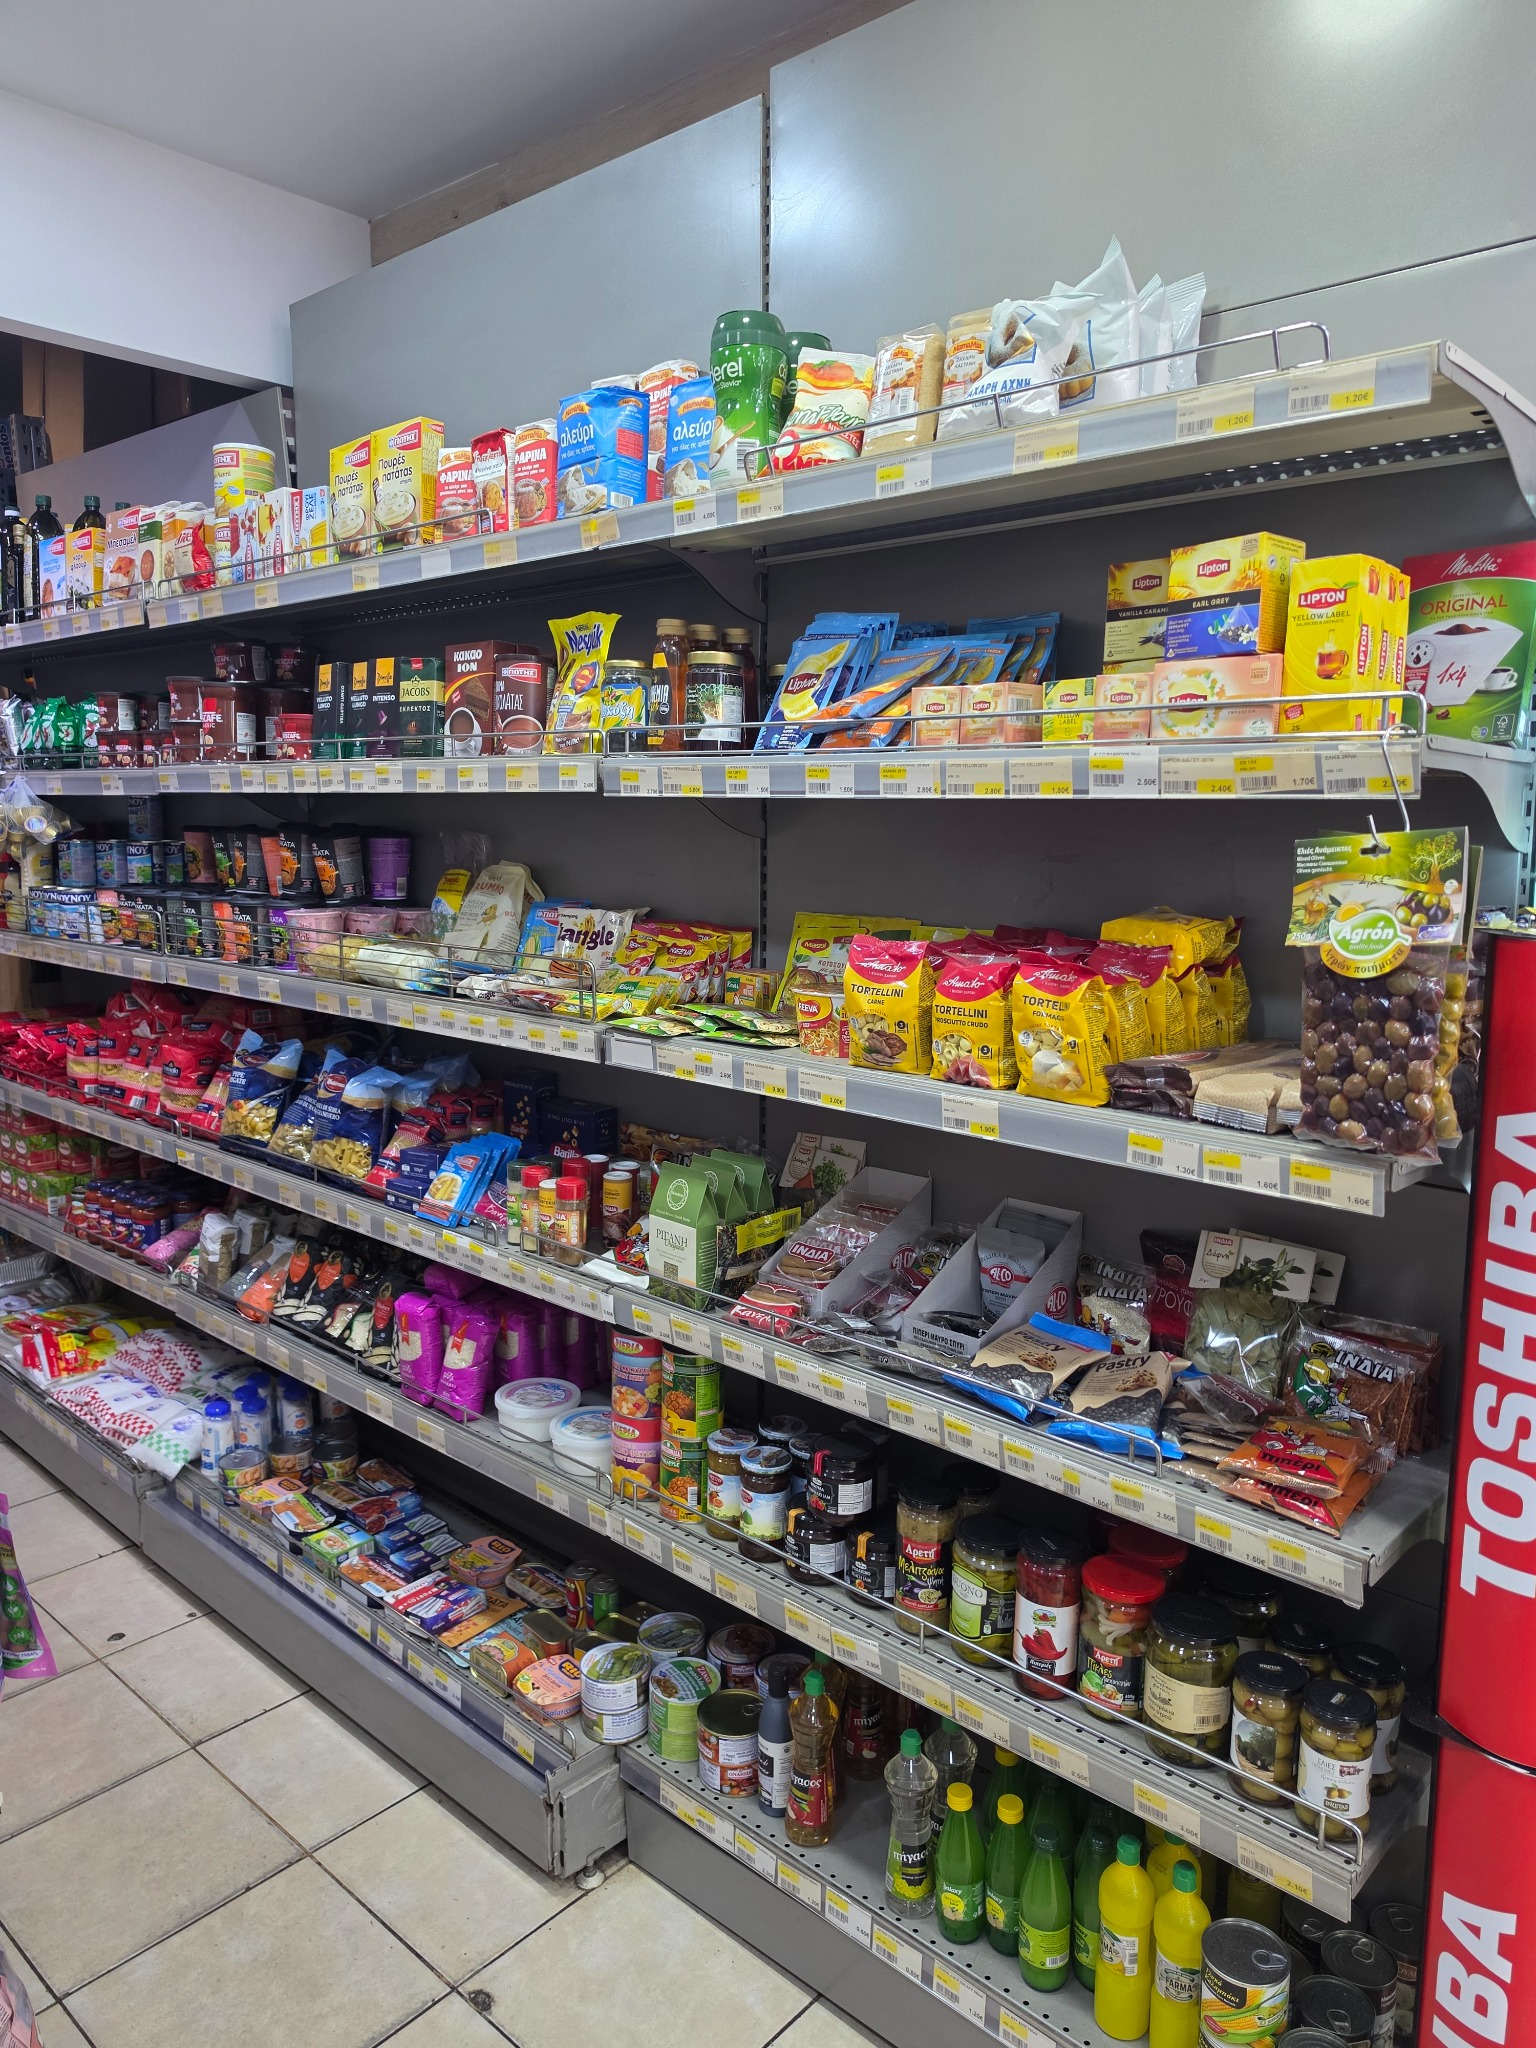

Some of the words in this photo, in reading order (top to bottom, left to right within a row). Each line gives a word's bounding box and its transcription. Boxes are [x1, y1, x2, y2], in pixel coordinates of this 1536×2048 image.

[1345, 392, 1369, 404] 1.20€
[1226, 414, 1249, 427] 1.20€
[560, 423, 594, 448] αλεύρι
[1199, 563, 1228, 576] Lipton
[1134, 578, 1160, 589] Lipton
[1192, 599, 1210, 608] EARL
[1210, 597, 1230, 606] GREY
[1300, 590, 1346, 606] LIPTON
[1420, 594, 1508, 616] ORIGINAL
[1118, 609, 1142, 618] VANILLA
[1292, 612, 1324, 622] YELLOW
[1324, 610, 1350, 618] LABEL
[1358, 626, 1368, 675] LIPTON
[401, 687, 430, 698] JACOBS
[1111, 693, 1131, 702] Lipton
[927, 703, 944, 711] Lipton
[973, 702, 991, 710] Lipton
[1137, 778, 1157, 786] 2.50€
[1292, 776, 1315, 786] 1.70€
[1210, 784, 1232, 793] 2.40€
[1353, 947, 1404, 974] ποιήματα
[850, 983, 904, 998] TORTELLINI
[867, 998, 885, 1006] CARNE
[934, 1004, 988, 1019] TORTELLINI
[967, 1020, 989, 1029] CRUDO
[979, 1125, 996, 1134] 1.90€
[1176, 1165, 1196, 1176] 1.30€
[1256, 1180, 1278, 1190] 1.60€
[1347, 1195, 1370, 1207] 1.60€
[792, 1244, 830, 1262] ΙΝΔΙΑ
[930, 1331, 949, 1345] ΜΑΥΡΟ
[1335, 1351, 1395, 1384] ΙΝΔΙΑ
[1286, 1879, 1309, 1895] 2.10€
[1165, 1977, 1194, 1994] FARMA
